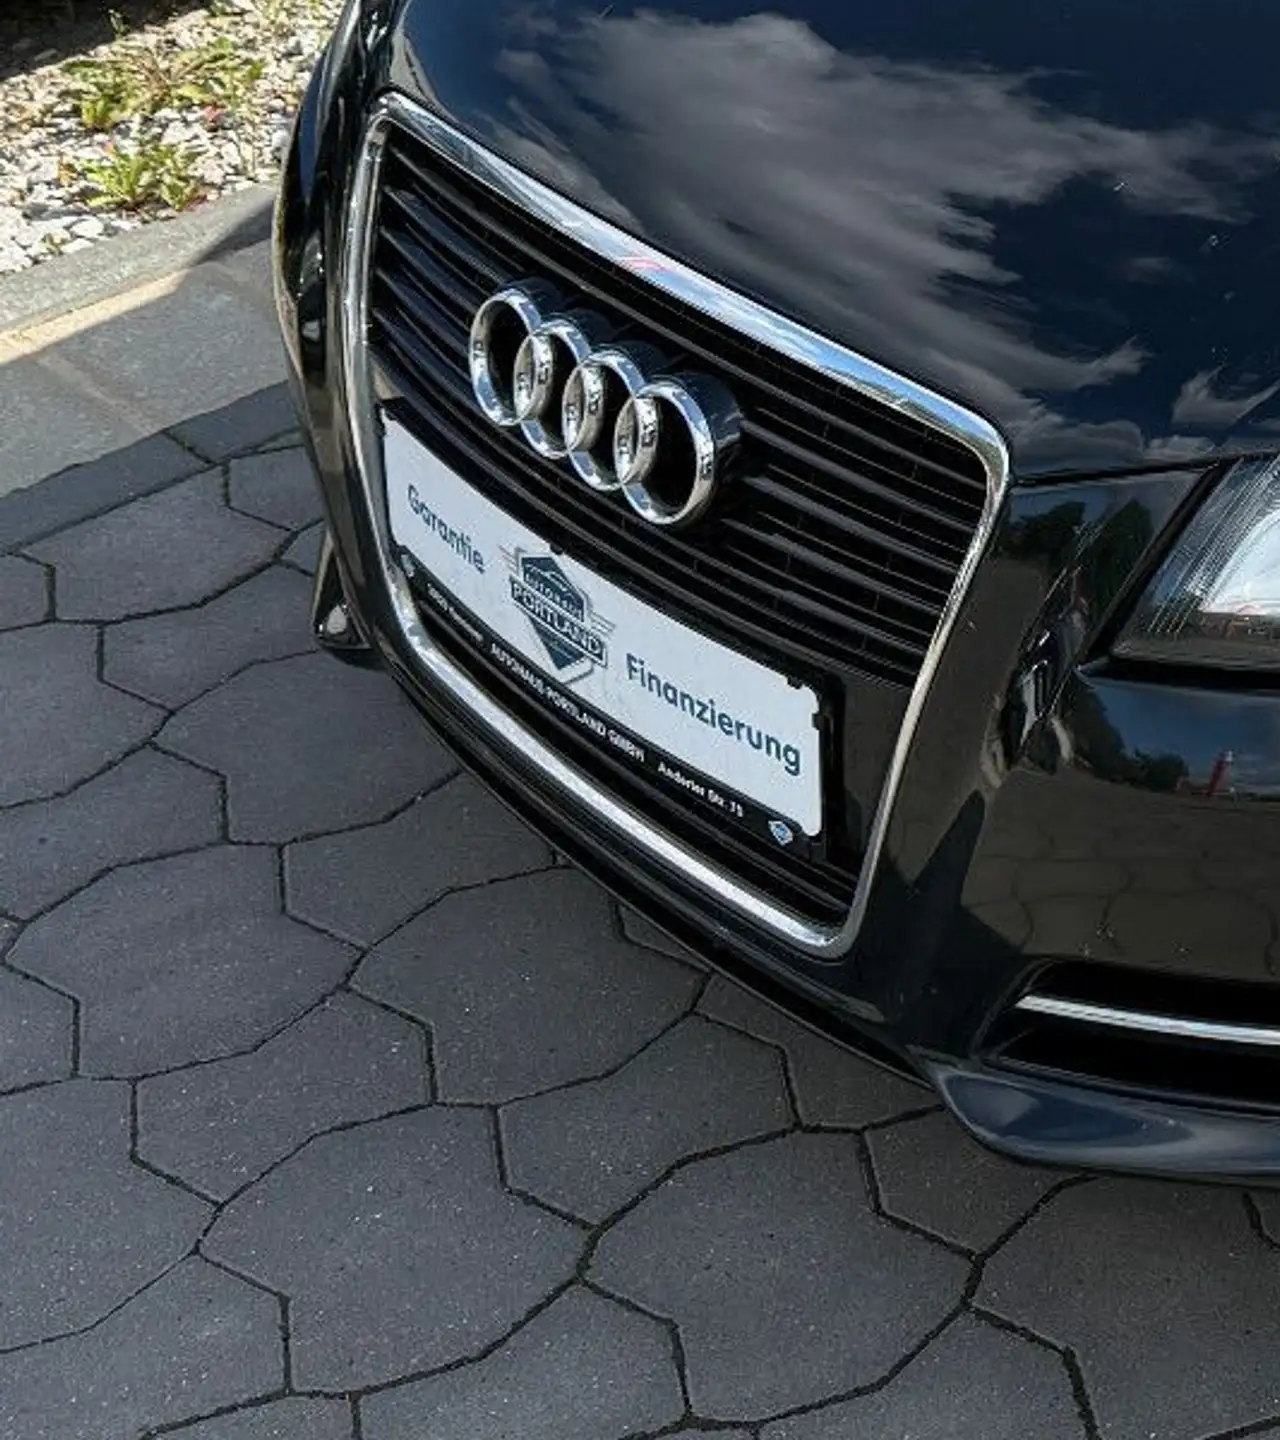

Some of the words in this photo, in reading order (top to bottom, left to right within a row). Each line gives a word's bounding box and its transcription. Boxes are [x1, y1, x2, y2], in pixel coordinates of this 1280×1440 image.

[407, 483, 486, 575] Garantie
[513, 584, 603, 656] PORTLAND
[547, 686, 607, 737] PORTLAND
[625, 652, 802, 777] Finanzierung
